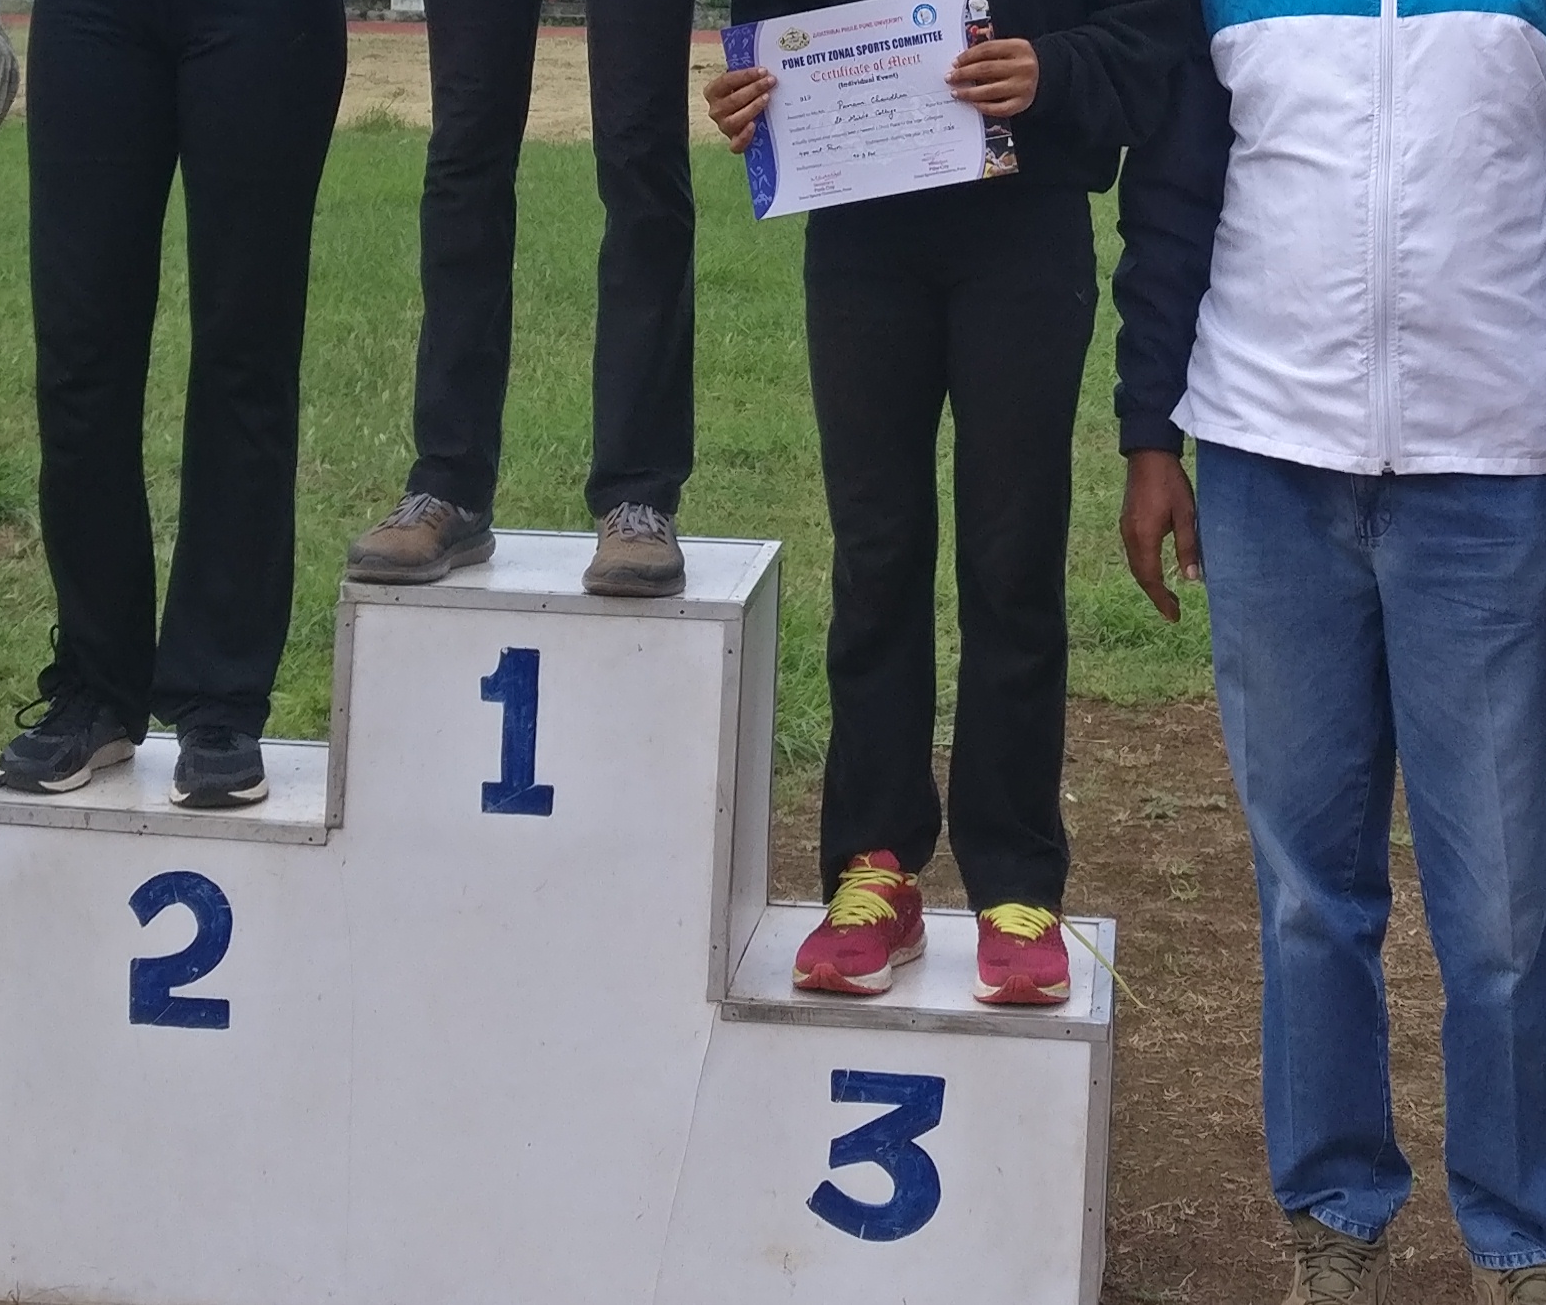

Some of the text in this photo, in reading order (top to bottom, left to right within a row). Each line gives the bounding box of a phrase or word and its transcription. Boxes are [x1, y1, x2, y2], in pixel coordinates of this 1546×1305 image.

[781, 30, 944, 70] PUNE CITY ZONAL SPORTS COMMITTEE
[809, 53, 922, 83] Certificate of Merit
[876, 72, 899, 84] Event)
[480, 647, 554, 816] 1
[128, 869, 233, 1030] 2
[808, 1068, 946, 1242] 3
